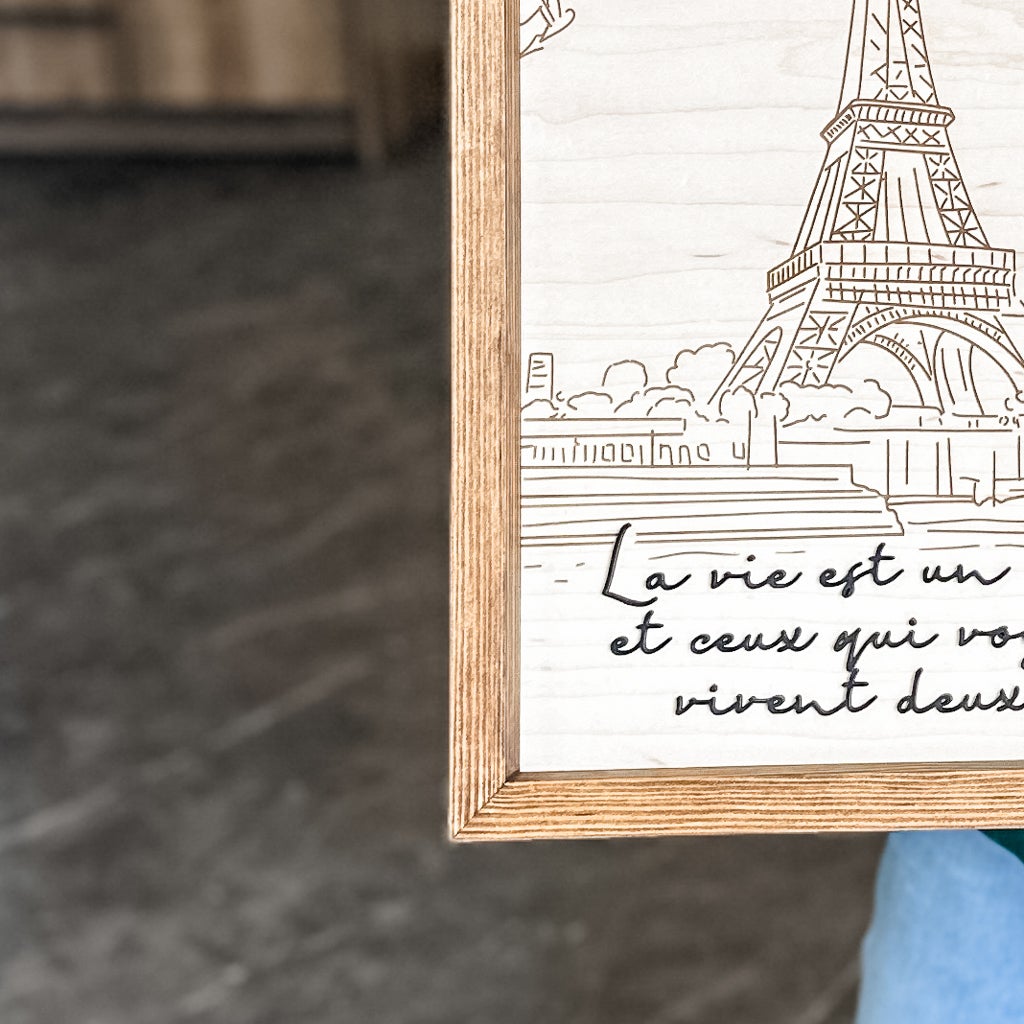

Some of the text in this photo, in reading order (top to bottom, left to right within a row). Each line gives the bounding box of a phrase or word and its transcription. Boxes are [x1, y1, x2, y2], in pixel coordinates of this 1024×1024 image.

[601, 522, 692, 608] La
[710, 554, 803, 591] vie
[818, 542, 905, 599] est
[921, 564, 1012, 586] un
[610, 610, 673, 656] et
[689, 626, 819, 655] ceux
[832, 617, 940, 669] qui
[674, 668, 877, 718] vivent
